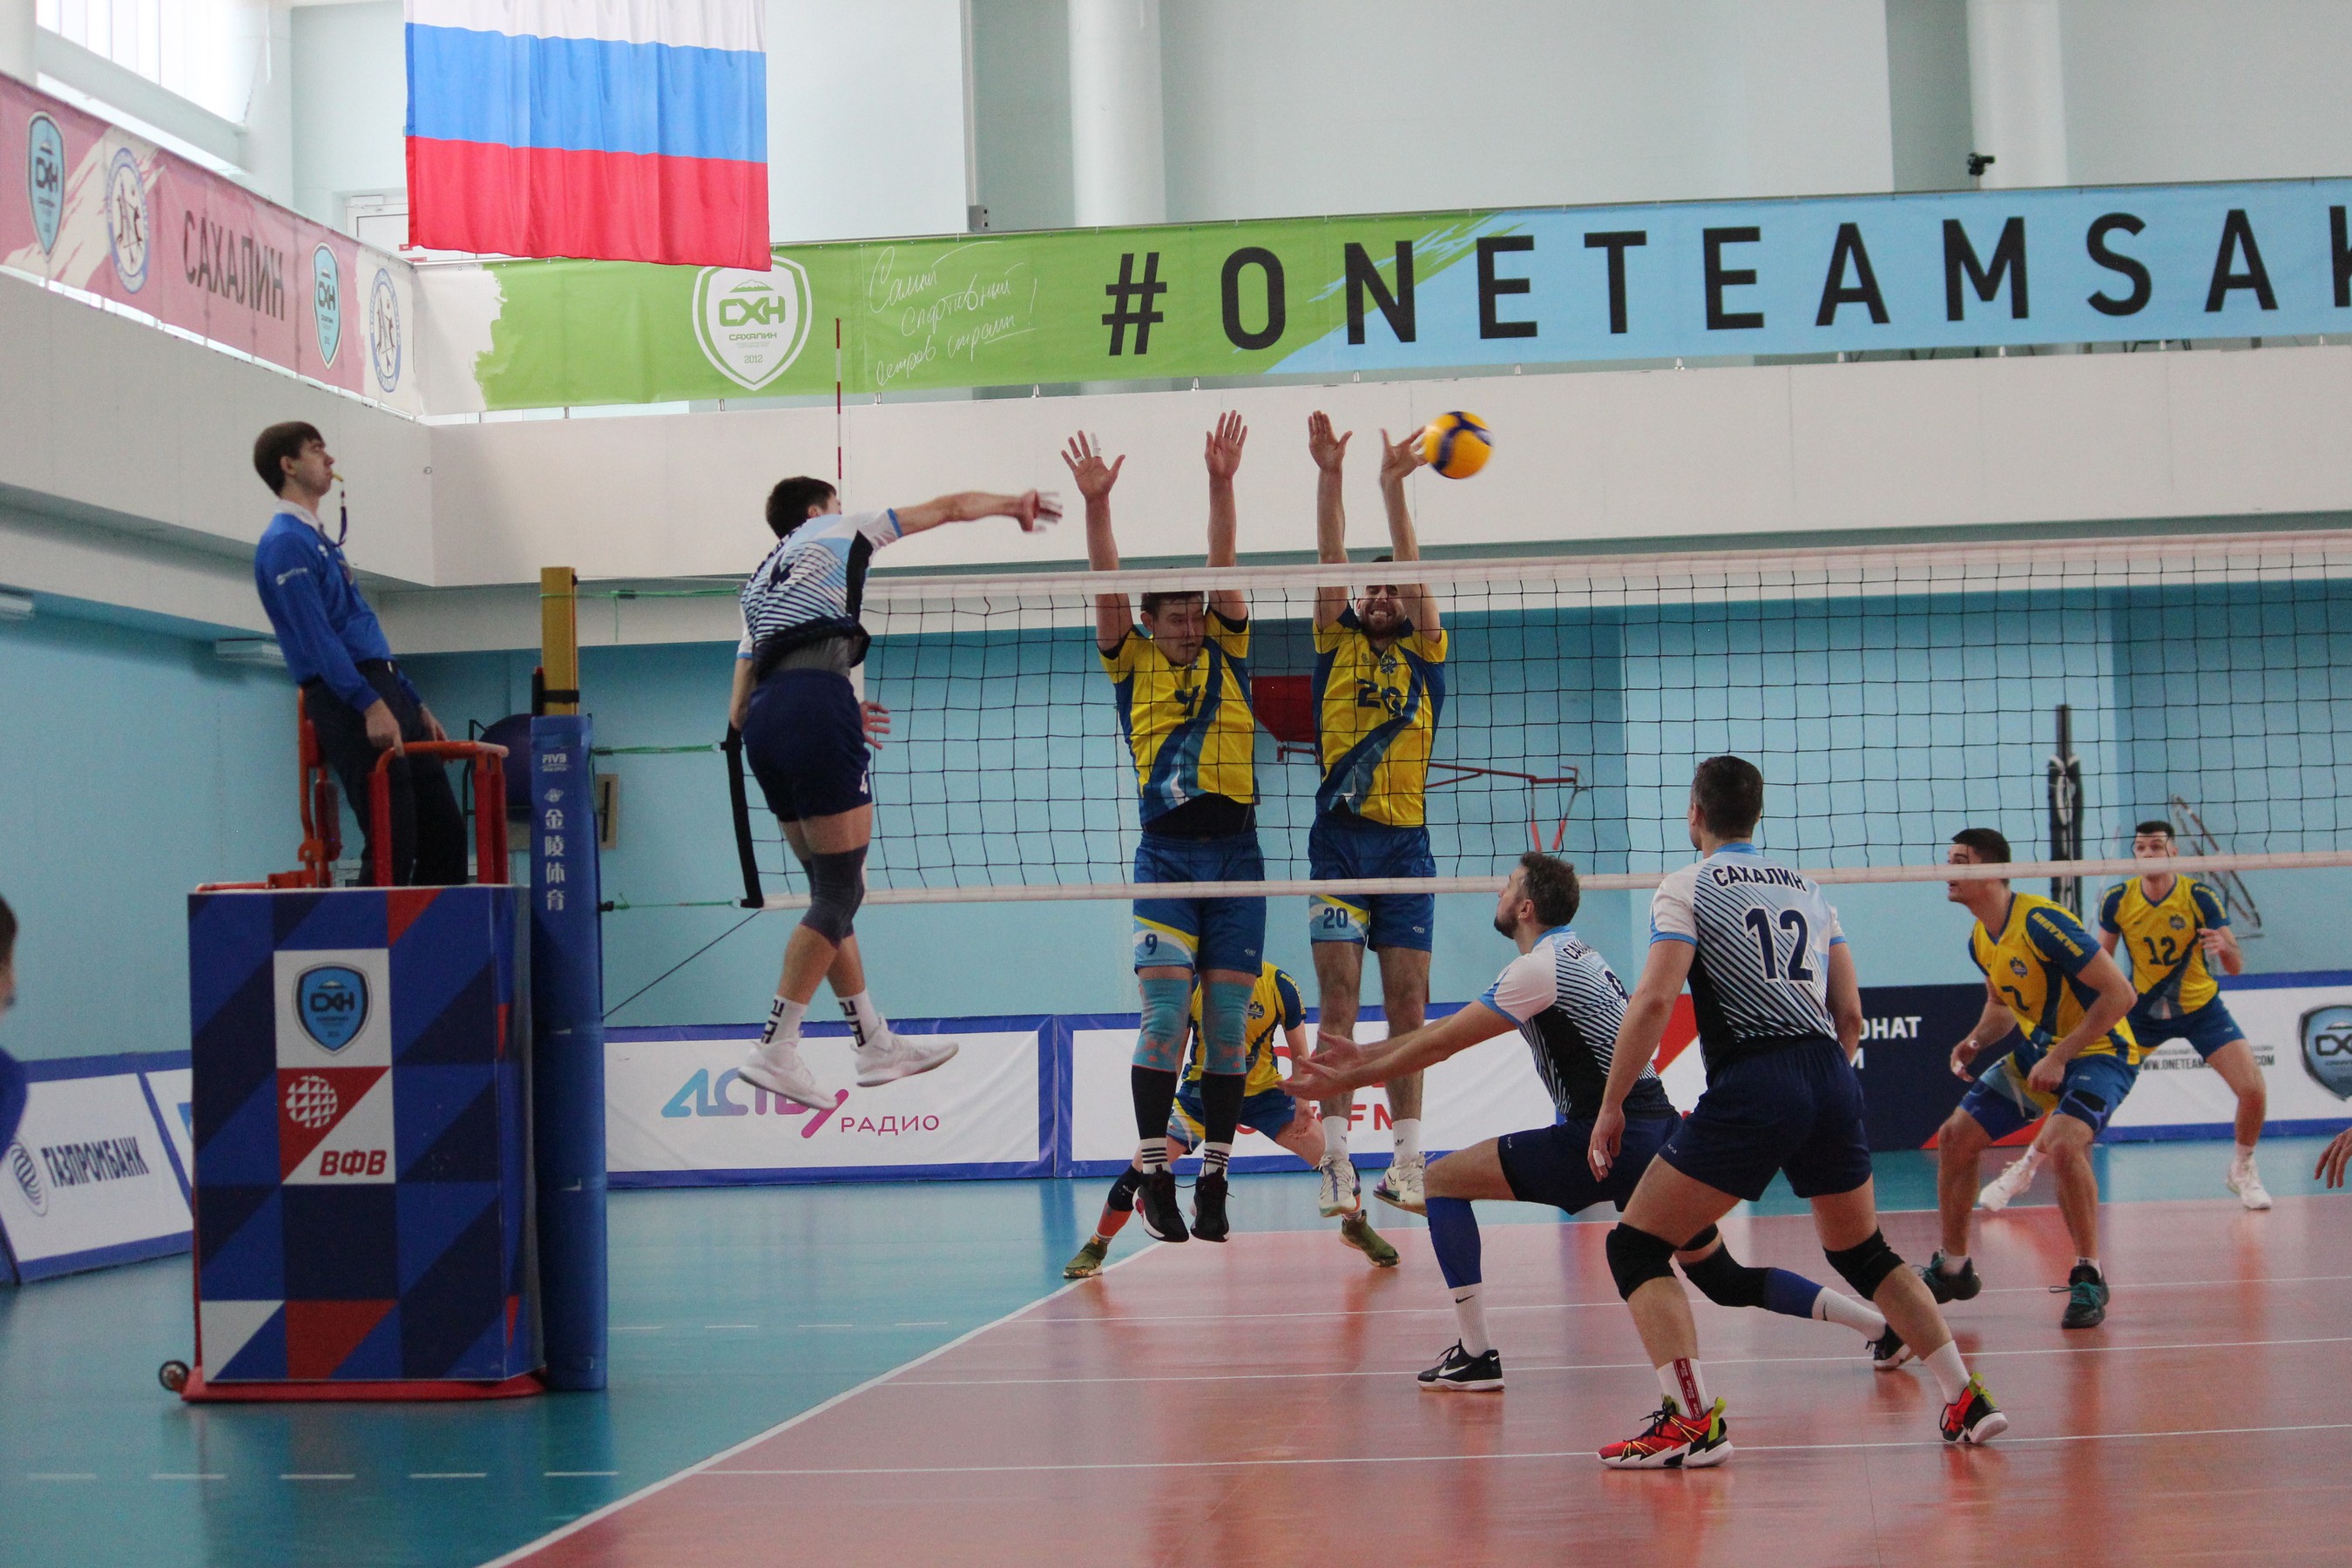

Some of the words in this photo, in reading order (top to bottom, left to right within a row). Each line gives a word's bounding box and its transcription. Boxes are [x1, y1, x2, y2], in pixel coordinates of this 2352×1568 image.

[182, 209, 285, 321] САХАЛИН
[728, 332, 777, 341] САХАЛИН
[744, 354, 763, 364] 2012
[542, 753, 567, 764] FIVB
[1712, 865, 1808, 893] САХАЛИН
[1322, 907, 1348, 929] 20
[1145, 932, 1158, 956] 9
[1744, 907, 1814, 983] 12
[2143, 936, 2180, 966] 12
[841, 1114, 940, 1137] РАДИО
[41, 1135, 149, 1188] ГАЗПРОМБАНК
[319, 1149, 387, 1176] ВФВ
